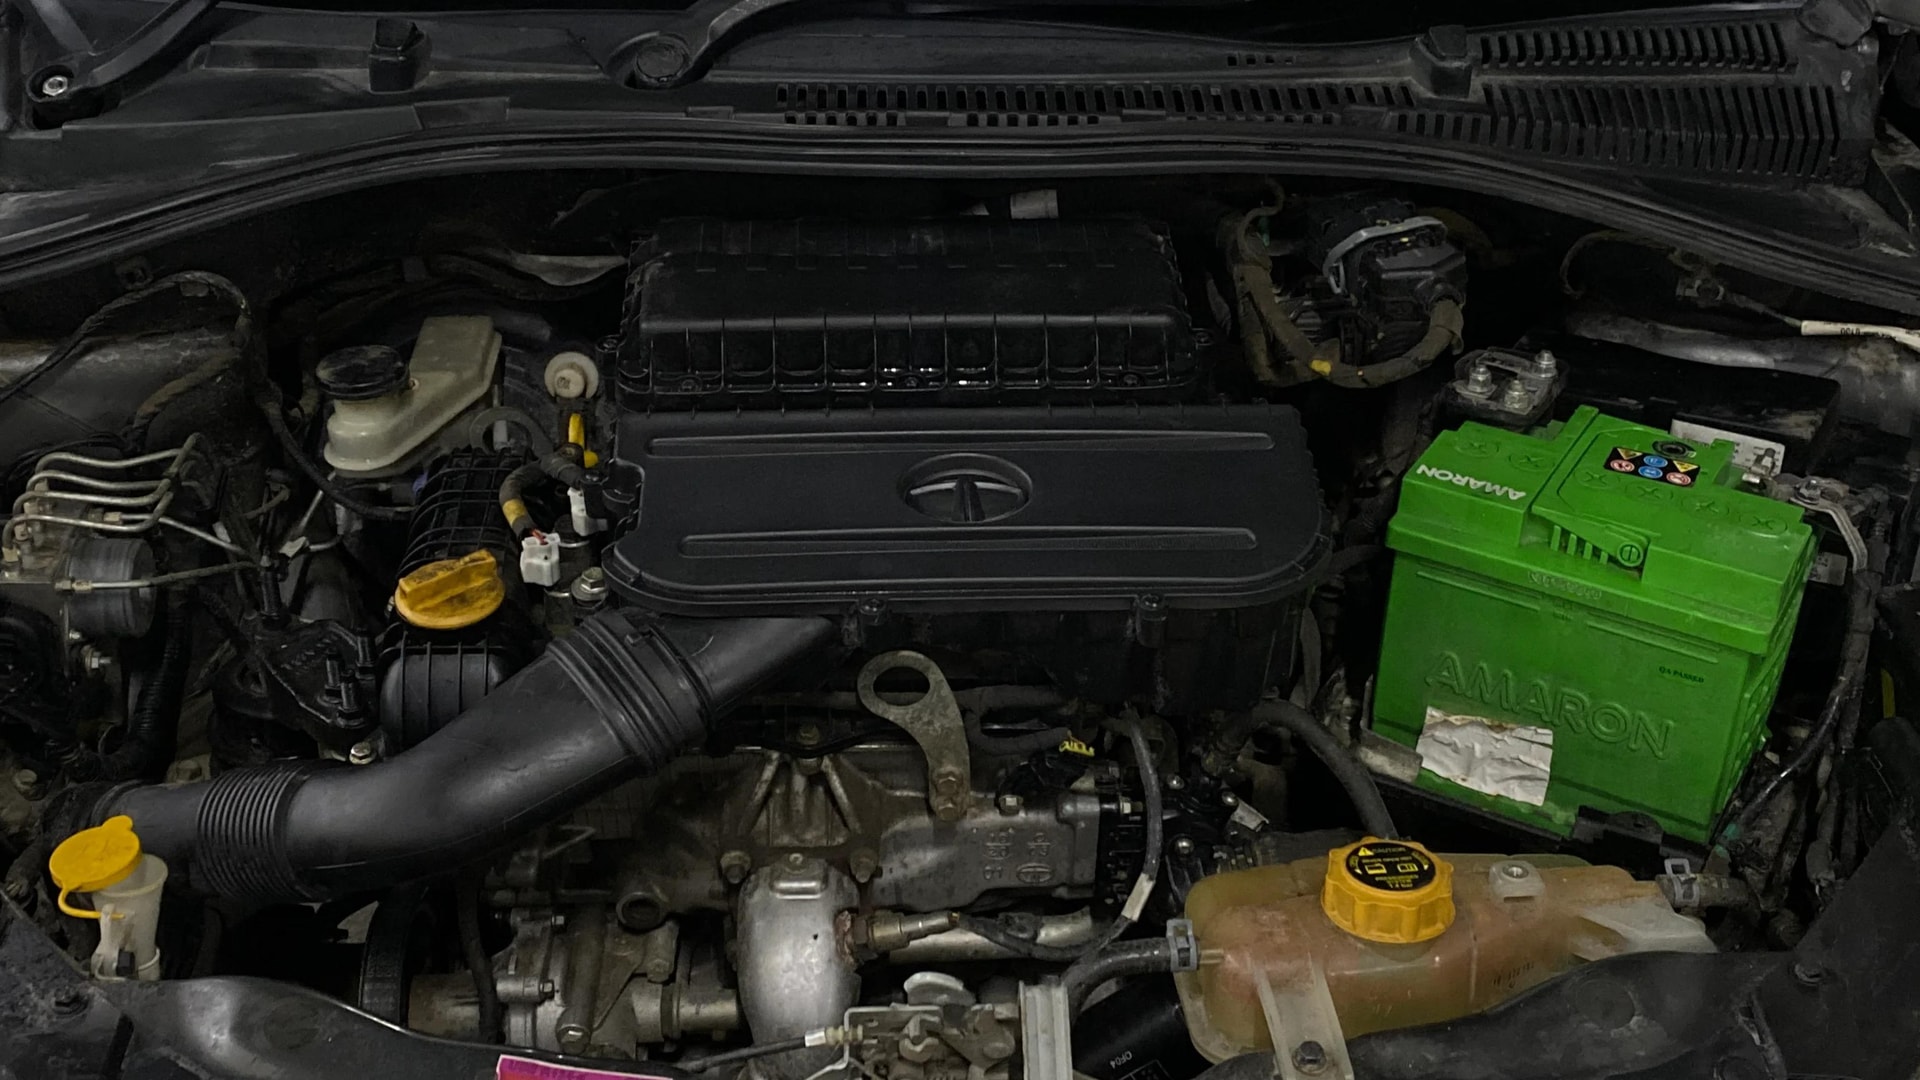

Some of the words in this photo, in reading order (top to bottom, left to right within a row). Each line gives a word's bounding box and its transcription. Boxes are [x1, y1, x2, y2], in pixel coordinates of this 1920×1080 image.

[1416, 464, 1526, 500] AMARON
[1425, 652, 1674, 759] AMARON
[1109, 1050, 1133, 1069] OF04
